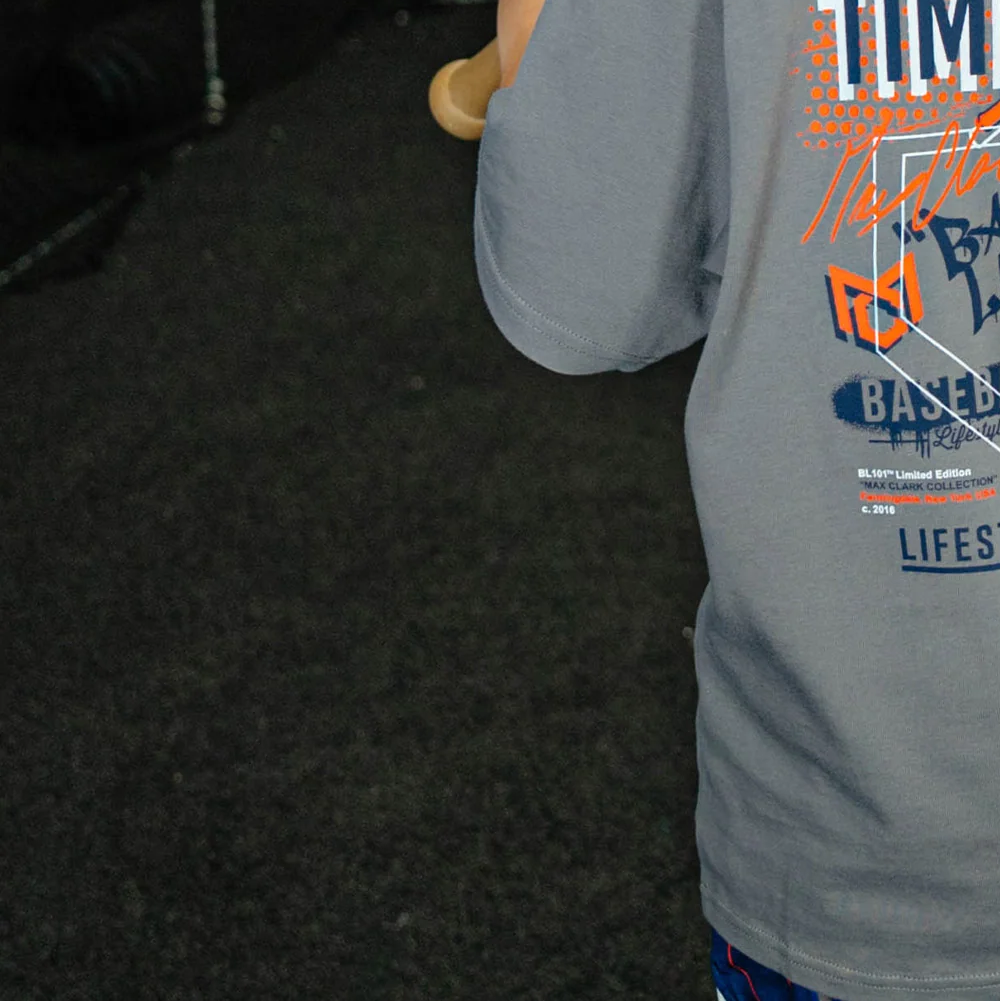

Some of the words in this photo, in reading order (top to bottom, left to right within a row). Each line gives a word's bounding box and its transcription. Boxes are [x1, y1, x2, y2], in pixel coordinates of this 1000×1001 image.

[895, 469, 933, 480] Limited
[935, 467, 972, 479] Edition
[888, 481, 923, 491] CLARK
[861, 506, 871, 514] c.
